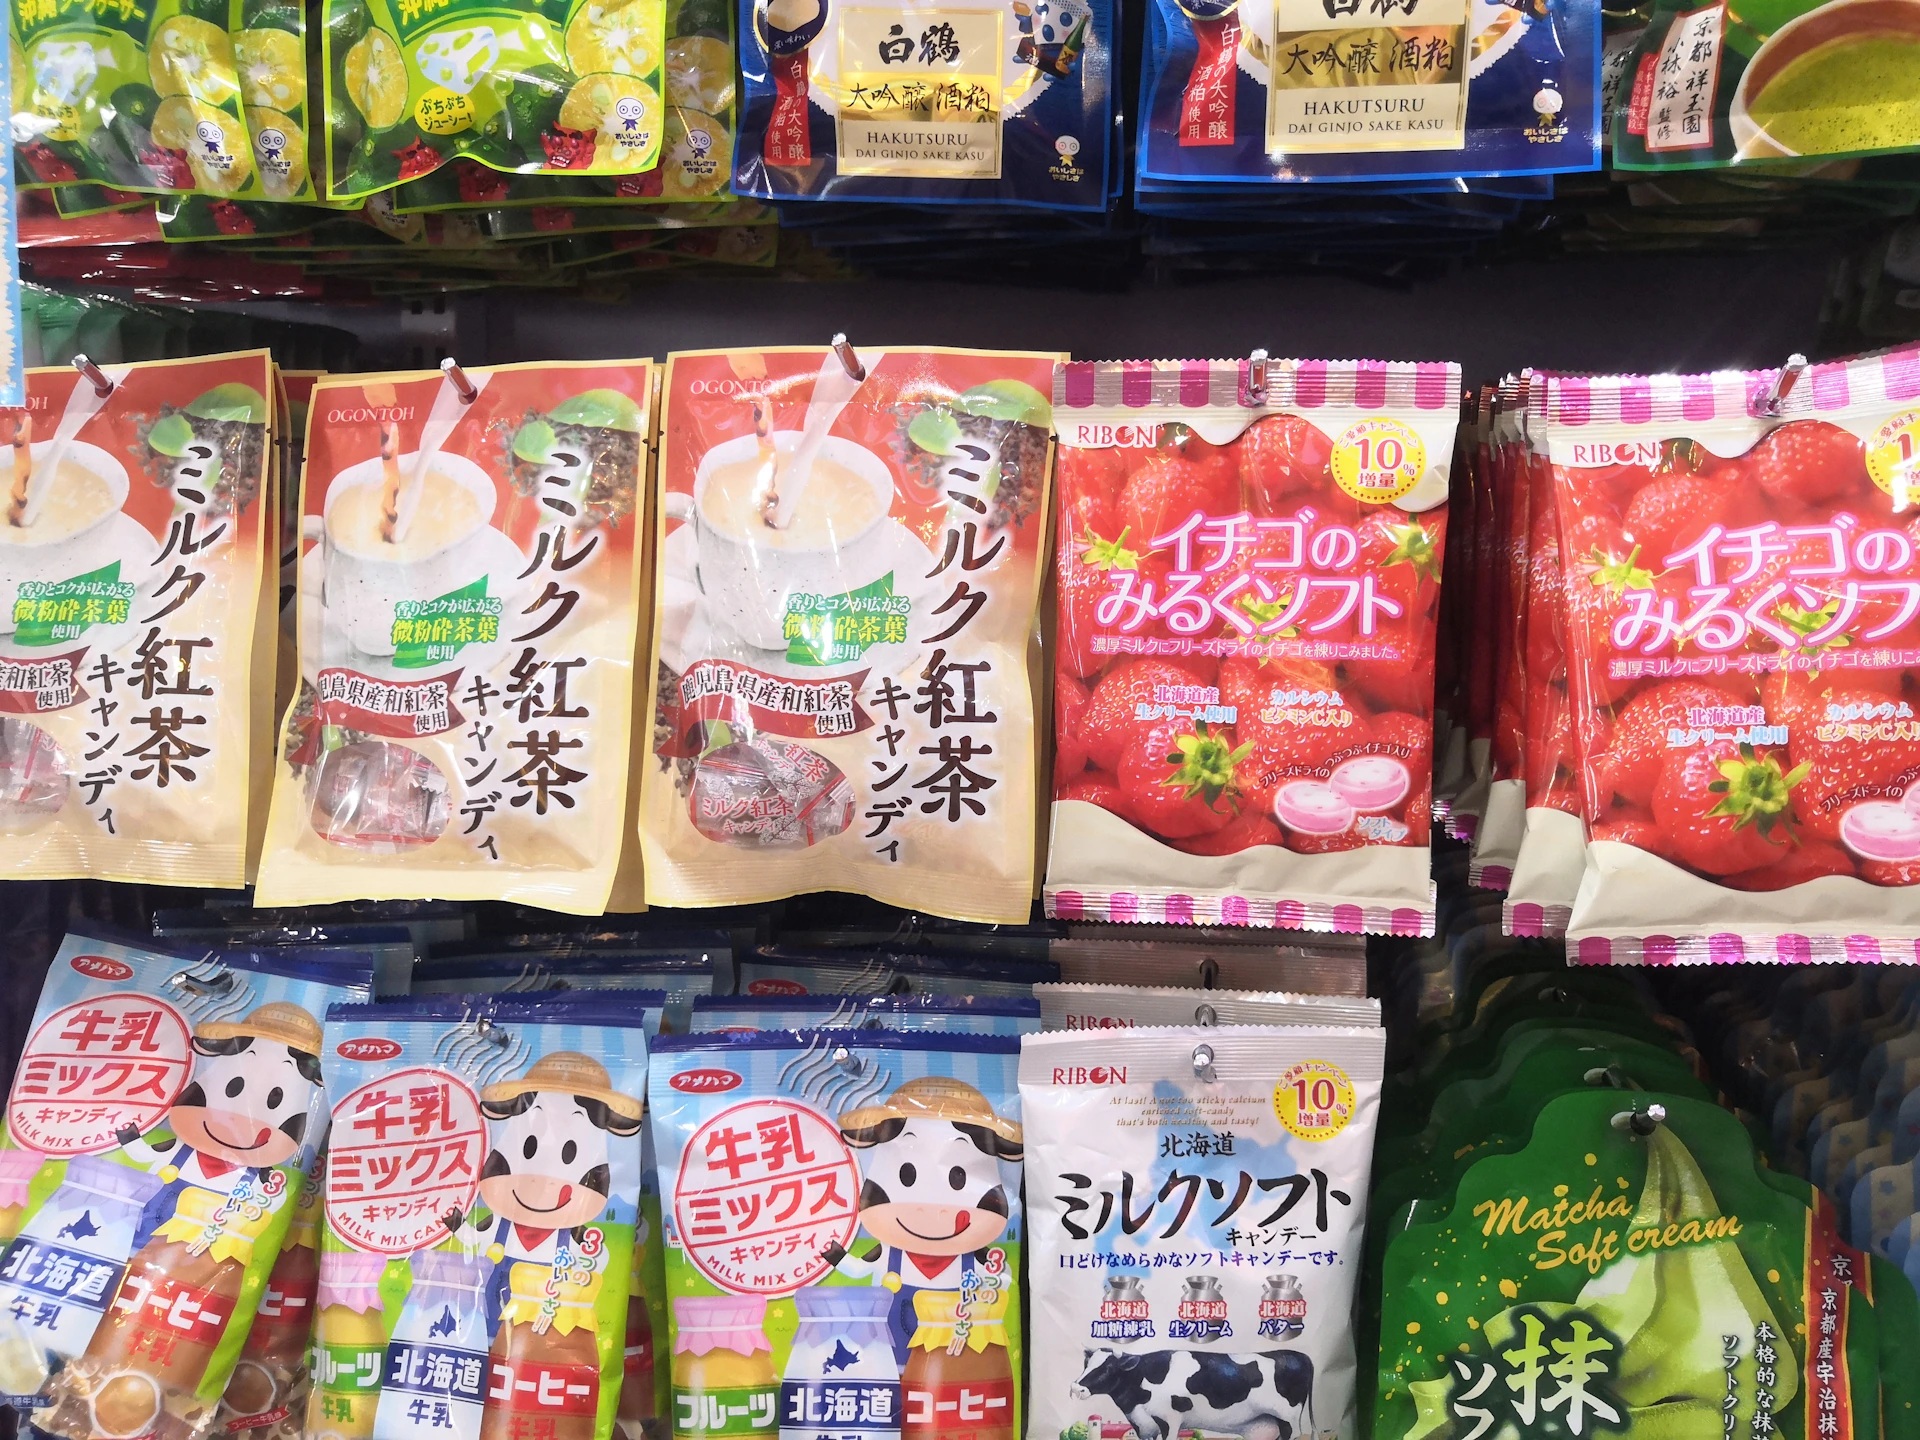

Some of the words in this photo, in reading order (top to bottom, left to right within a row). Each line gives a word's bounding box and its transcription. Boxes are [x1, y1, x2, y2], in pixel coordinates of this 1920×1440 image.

[877, 22, 962, 67] 白鶴
[420, 95, 466, 116] ぷちぷち
[1187, 64, 1214, 139] 酒粕使用
[1303, 98, 1426, 116] HAKUTSURU
[615, 132, 649, 140] おいしさは
[867, 131, 969, 147] HAKUTSURU
[1288, 122, 1316, 134] DAI
[1319, 121, 1363, 134] GINJO
[1368, 120, 1404, 131] SAKE
[1407, 118, 1444, 131] KASU
[855, 148, 878, 160] DAI
[881, 149, 919, 161] GINJO
[922, 150, 953, 161] SAKE
[955, 150, 985, 162] KASU
[327, 406, 415, 423] OGONTOH
[1077, 424, 1158, 447] RIBON
[1573, 441, 1662, 466] RIBON
[1357, 472, 1397, 489] 増量
[1149, 509, 1358, 572] イチゴの
[1663, 512, 1915, 587] イチゴの
[18, 582, 136, 598] 香りとコクが広がる
[122, 445, 228, 788] ミルク紅茶
[395, 597, 503, 615] 香りとコクが広がる
[787, 593, 910, 614] 香りとコクが広がる
[1096, 573, 1403, 636] みるくソフト
[51, 624, 81, 639] 使用
[501, 452, 599, 816] ミルク紅茶
[911, 443, 1006, 823] ミルク紅茶
[426, 645, 455, 660] 使用
[828, 643, 861, 660] 使用
[1091, 637, 1400, 660] 濃厚ミルクにフリーズドライのイチゴを練りこみました。
[1610, 648, 1920, 679] 濃厚ミルクにフリーズドライのイチゴを練りこ
[38, 687, 70, 708] 使用
[681, 665, 854, 714] 鹿児島県産和紅茶
[1154, 685, 1219, 705] 北海道産
[1269, 690, 1343, 708] カルシウム
[415, 710, 447, 733] 使用
[815, 712, 854, 733] 使用
[1134, 704, 1238, 724] 生クリーム使用
[1260, 708, 1353, 728] ビタミンC入り
[1687, 704, 1766, 727] 北海道産
[1826, 701, 1914, 721] カルシウム
[79, 654, 125, 835] キャンディ
[1666, 724, 1789, 748] 生クリーム使用
[459, 675, 502, 860] キャンディ
[1325, 742, 1411, 767] つぶつぶイチゴ入り
[864, 676, 911, 863] キャンディ
[1259, 765, 1331, 788] フリーズドライの
[702, 793, 795, 818] ミルク紅茶
[1820, 784, 1904, 812] フリーズドライの
[723, 817, 776, 834] キャンディ
[1358, 816, 1391, 829] ソフト
[1370, 827, 1408, 841] タイプ
[59, 1008, 163, 1053] 牛乳
[18, 1060, 170, 1100] ミックス
[677, 1072, 734, 1089] アメハマ
[1052, 1066, 1127, 1085] RIBON
[35, 1107, 123, 1125] キャンディ
[353, 1082, 458, 1141] 牛乳
[1297, 1112, 1331, 1127] 増量
[15, 1112, 41, 1141] MILK
[43, 1135, 73, 1148] MIX
[705, 1112, 816, 1181] 牛乳
[1160, 1130, 1237, 1158] 北海道
[331, 1139, 475, 1193] ミックス
[243, 1171, 287, 1221] 3つの
[688, 1170, 848, 1237] ミックス
[1054, 1168, 1351, 1240] ミルクソフト
[362, 1197, 441, 1224] キャンディ
[1473, 1184, 1634, 1237] Matcha
[338, 1211, 373, 1243] MILK
[380, 1232, 408, 1246] MIX
[1225, 1227, 1317, 1247] キャンデー
[573, 1228, 602, 1285] 3つの
[730, 1232, 817, 1266] キャンディ
[1535, 1226, 1619, 1276] Soft
[1628, 1213, 1744, 1254] cream
[2, 1244, 115, 1301] 北海道
[706, 1254, 746, 1285] MILK
[753, 1272, 788, 1287] MIX
[1059, 1250, 1345, 1270] 口どけなめらかなソフトキャンデーです。
[980, 1249, 1004, 1304] 3つの
[10, 1294, 60, 1331] 牛乳
[114, 1274, 222, 1331] コーヒー
[1100, 1300, 1149, 1319] 北海道
[1178, 1300, 1228, 1319] 北海道
[1258, 1299, 1307, 1318] 北海道
[1090, 1319, 1156, 1339] 加糖練乳
[1168, 1320, 1234, 1339] 生クリーム
[1258, 1319, 1305, 1337] バター
[126, 1331, 178, 1368] 牛乳
[391, 1348, 483, 1395] 北海道
[1502, 1313, 1621, 1436] 抹
[1816, 1287, 1839, 1440] 京都産宇治抹
[489, 1364, 591, 1407] コーヒー
[321, 1394, 355, 1423] 牛乳
[406, 1398, 454, 1430] 牛乳
[676, 1392, 776, 1431] フルーツ
[789, 1386, 893, 1425] 北海道
[906, 1388, 1007, 1424] コーヒー
